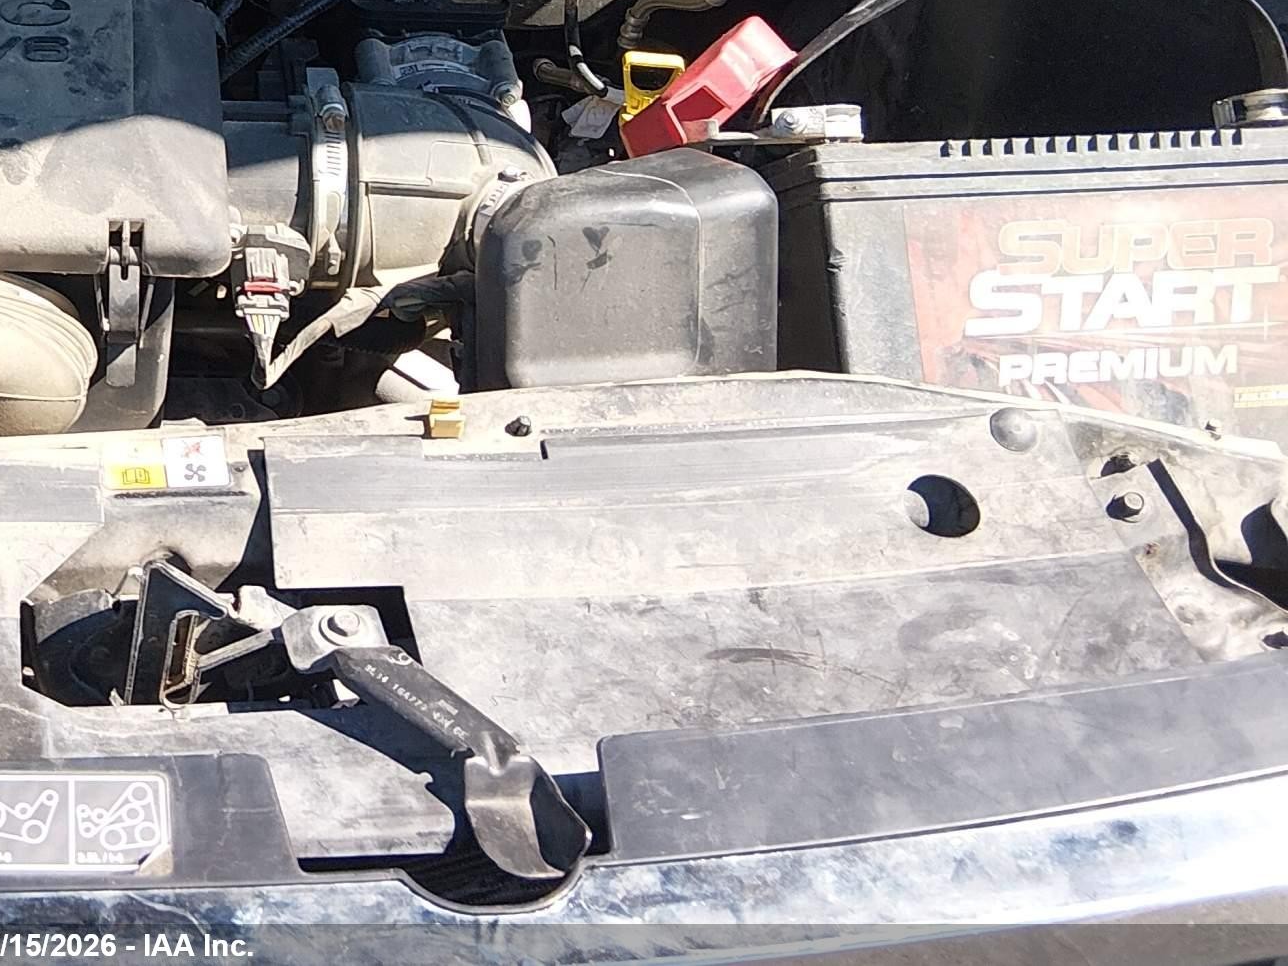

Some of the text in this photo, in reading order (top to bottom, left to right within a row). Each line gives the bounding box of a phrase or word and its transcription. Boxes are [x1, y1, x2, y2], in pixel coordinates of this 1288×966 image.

[998, 217, 1274, 276] SUPER
[964, 265, 1281, 337] START
[998, 345, 1238, 385] PREMIUM
